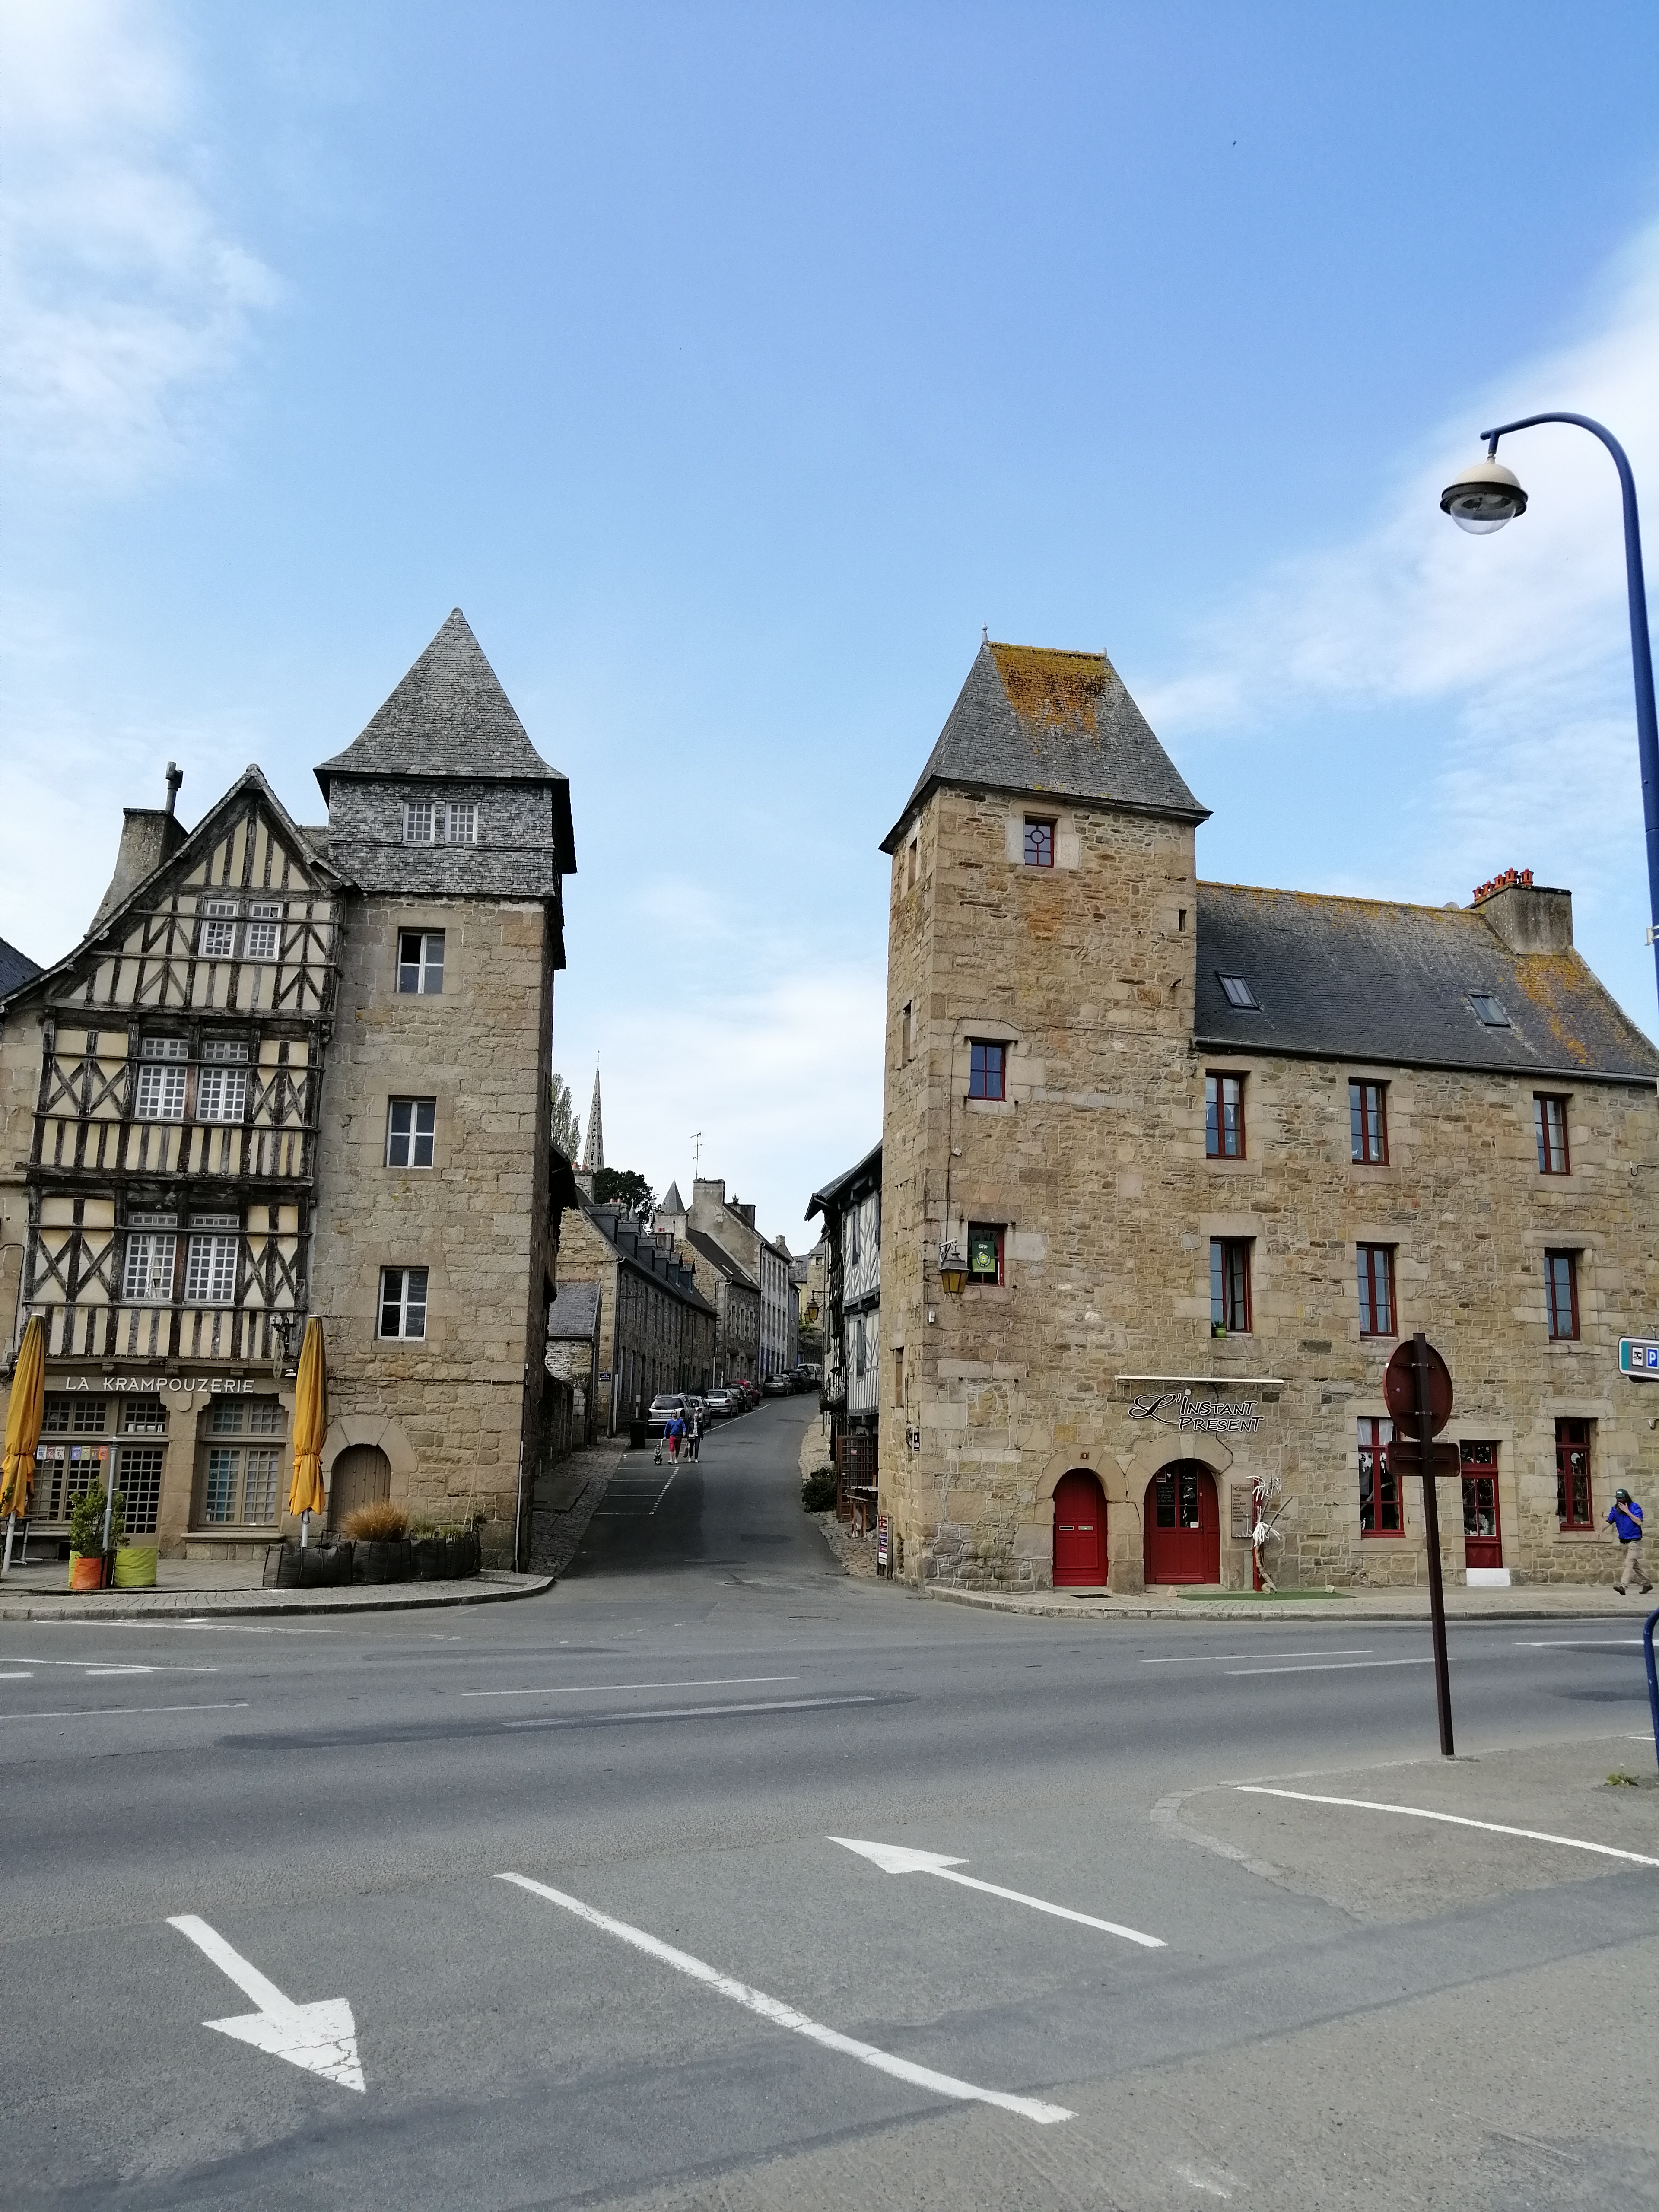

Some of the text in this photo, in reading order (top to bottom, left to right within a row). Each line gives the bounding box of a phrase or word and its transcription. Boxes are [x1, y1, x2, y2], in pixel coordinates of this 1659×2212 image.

[1649, 1351, 1656, 1364] P
[66, 1377, 255, 1393] LA KRAMPOUZERIE
[1179, 1416, 1264, 1432] PRESENT
